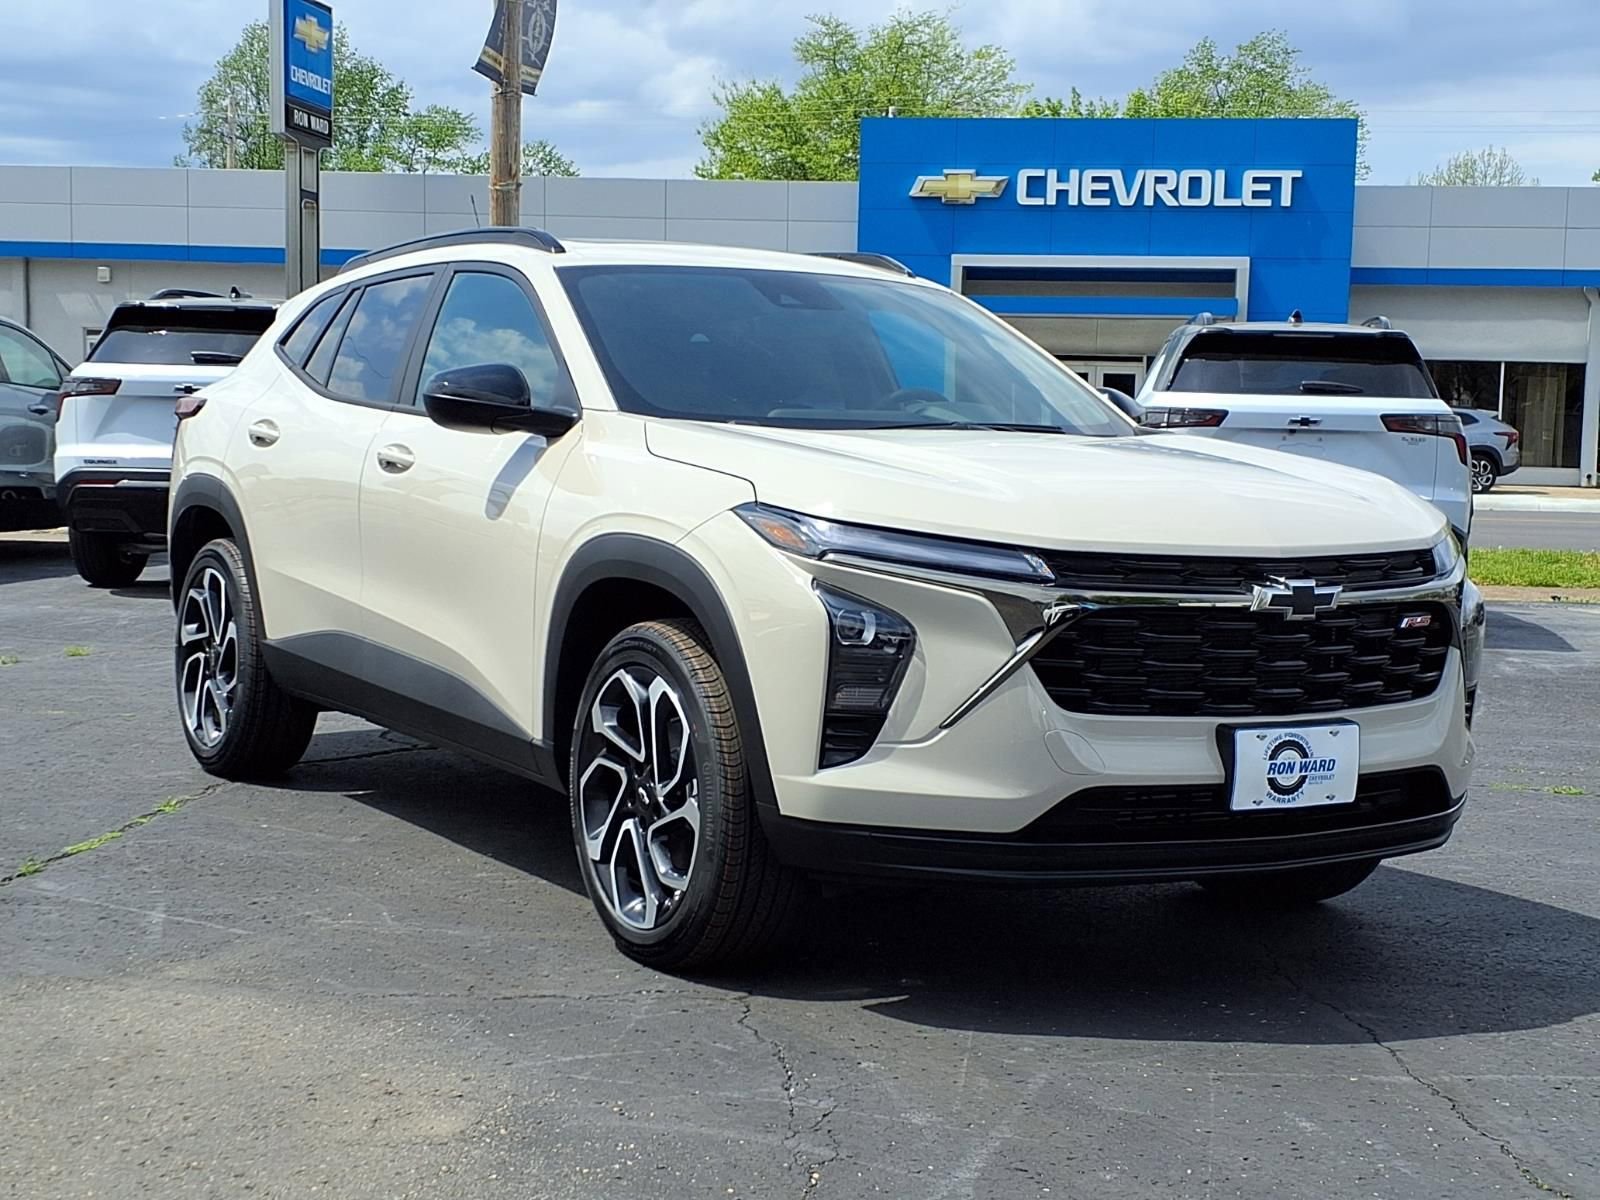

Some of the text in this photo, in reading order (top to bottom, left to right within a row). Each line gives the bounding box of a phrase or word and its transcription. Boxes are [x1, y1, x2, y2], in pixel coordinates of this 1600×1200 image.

[290, 65, 332, 95] CHEVROLET
[293, 108, 329, 135] RON WARD
[1016, 168, 1303, 207] CHEVROLET
[1400, 615, 1432, 628] RS
[1263, 732, 1314, 760] LIFETIME POWERTRAIN
[1267, 759, 1336, 775] RON WARD
[1266, 789, 1305, 804] WARRANTY
